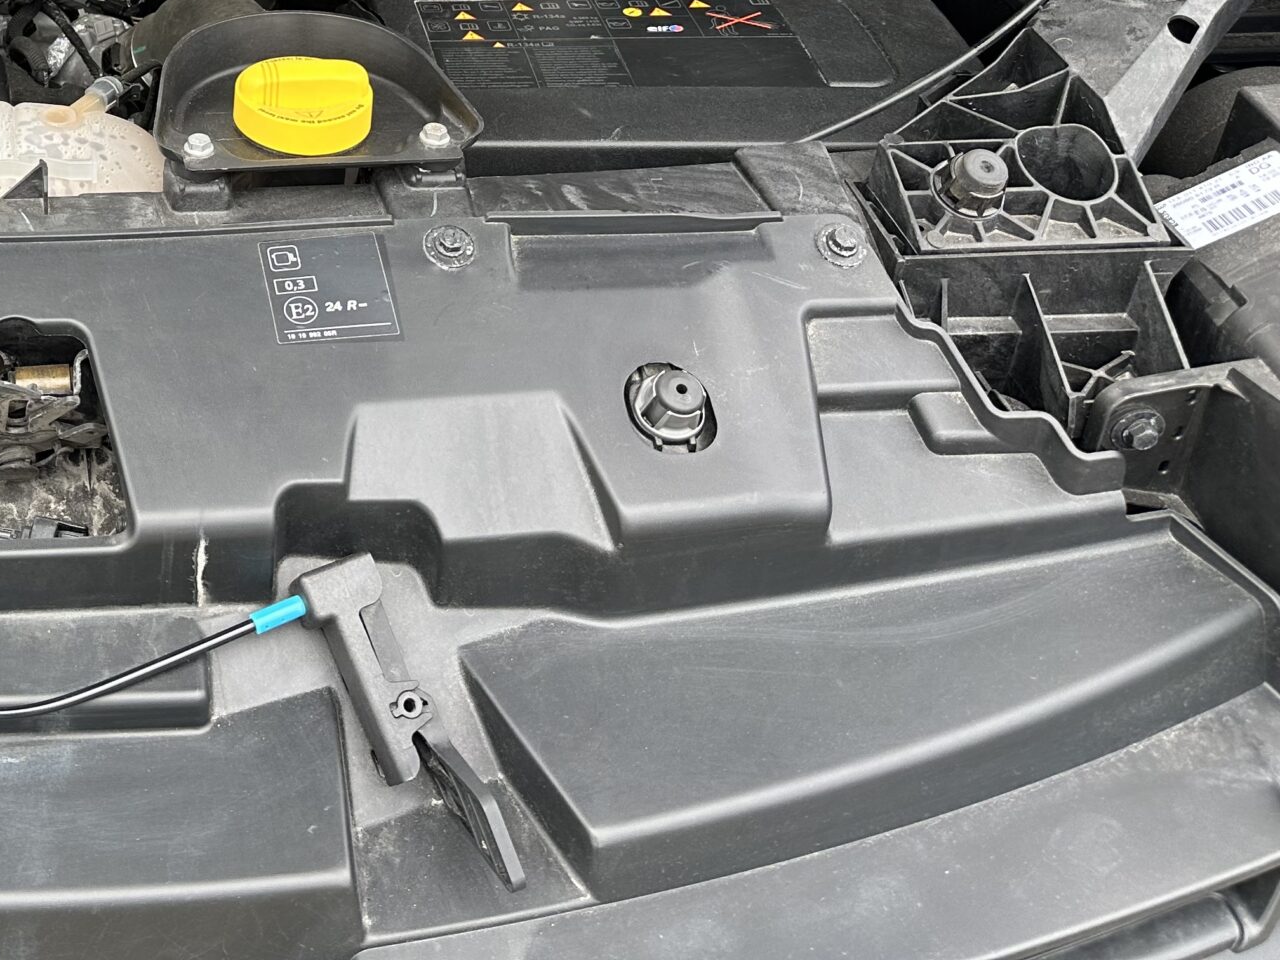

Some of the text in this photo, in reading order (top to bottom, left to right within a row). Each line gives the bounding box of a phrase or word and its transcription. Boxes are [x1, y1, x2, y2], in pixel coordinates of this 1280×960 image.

[646, 24, 670, 33] elf
[284, 279, 306, 292] 0,3
[288, 302, 315, 320] E2
[324, 300, 343, 312] 24
